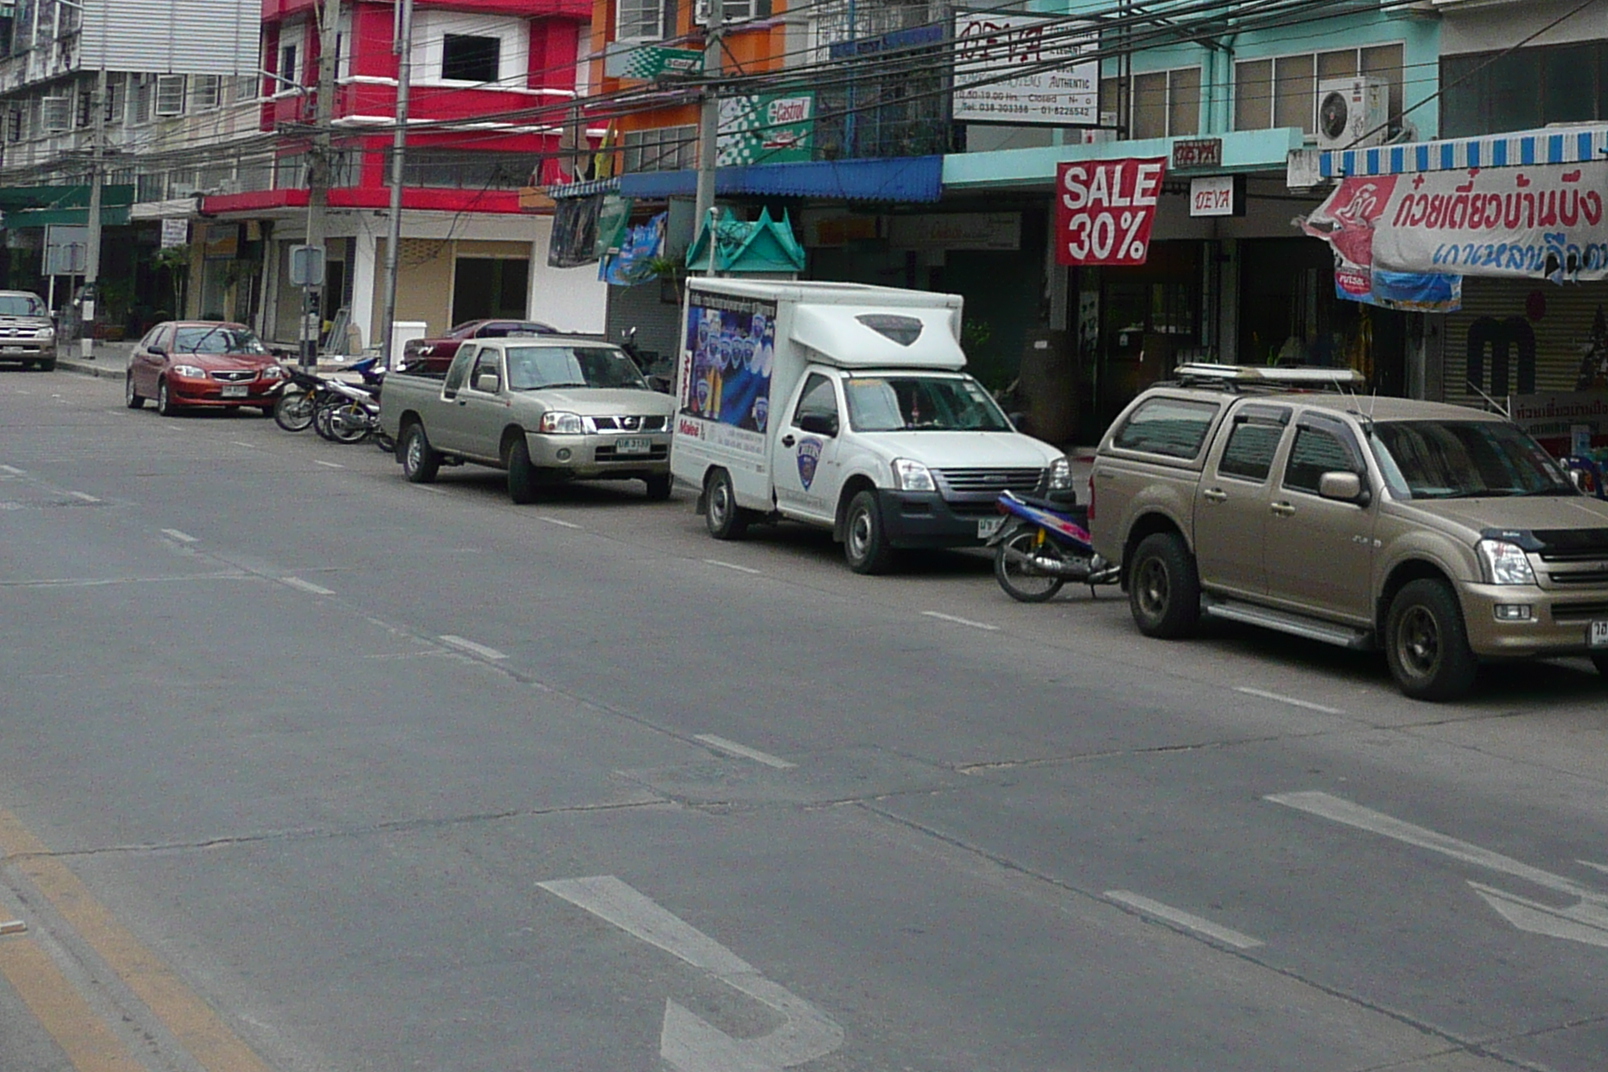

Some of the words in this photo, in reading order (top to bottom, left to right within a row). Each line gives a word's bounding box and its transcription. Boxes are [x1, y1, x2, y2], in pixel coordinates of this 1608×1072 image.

[1063, 162, 1162, 210] SALE
[1195, 189, 1230, 210] DEVA
[1068, 210, 1147, 260] 30%
